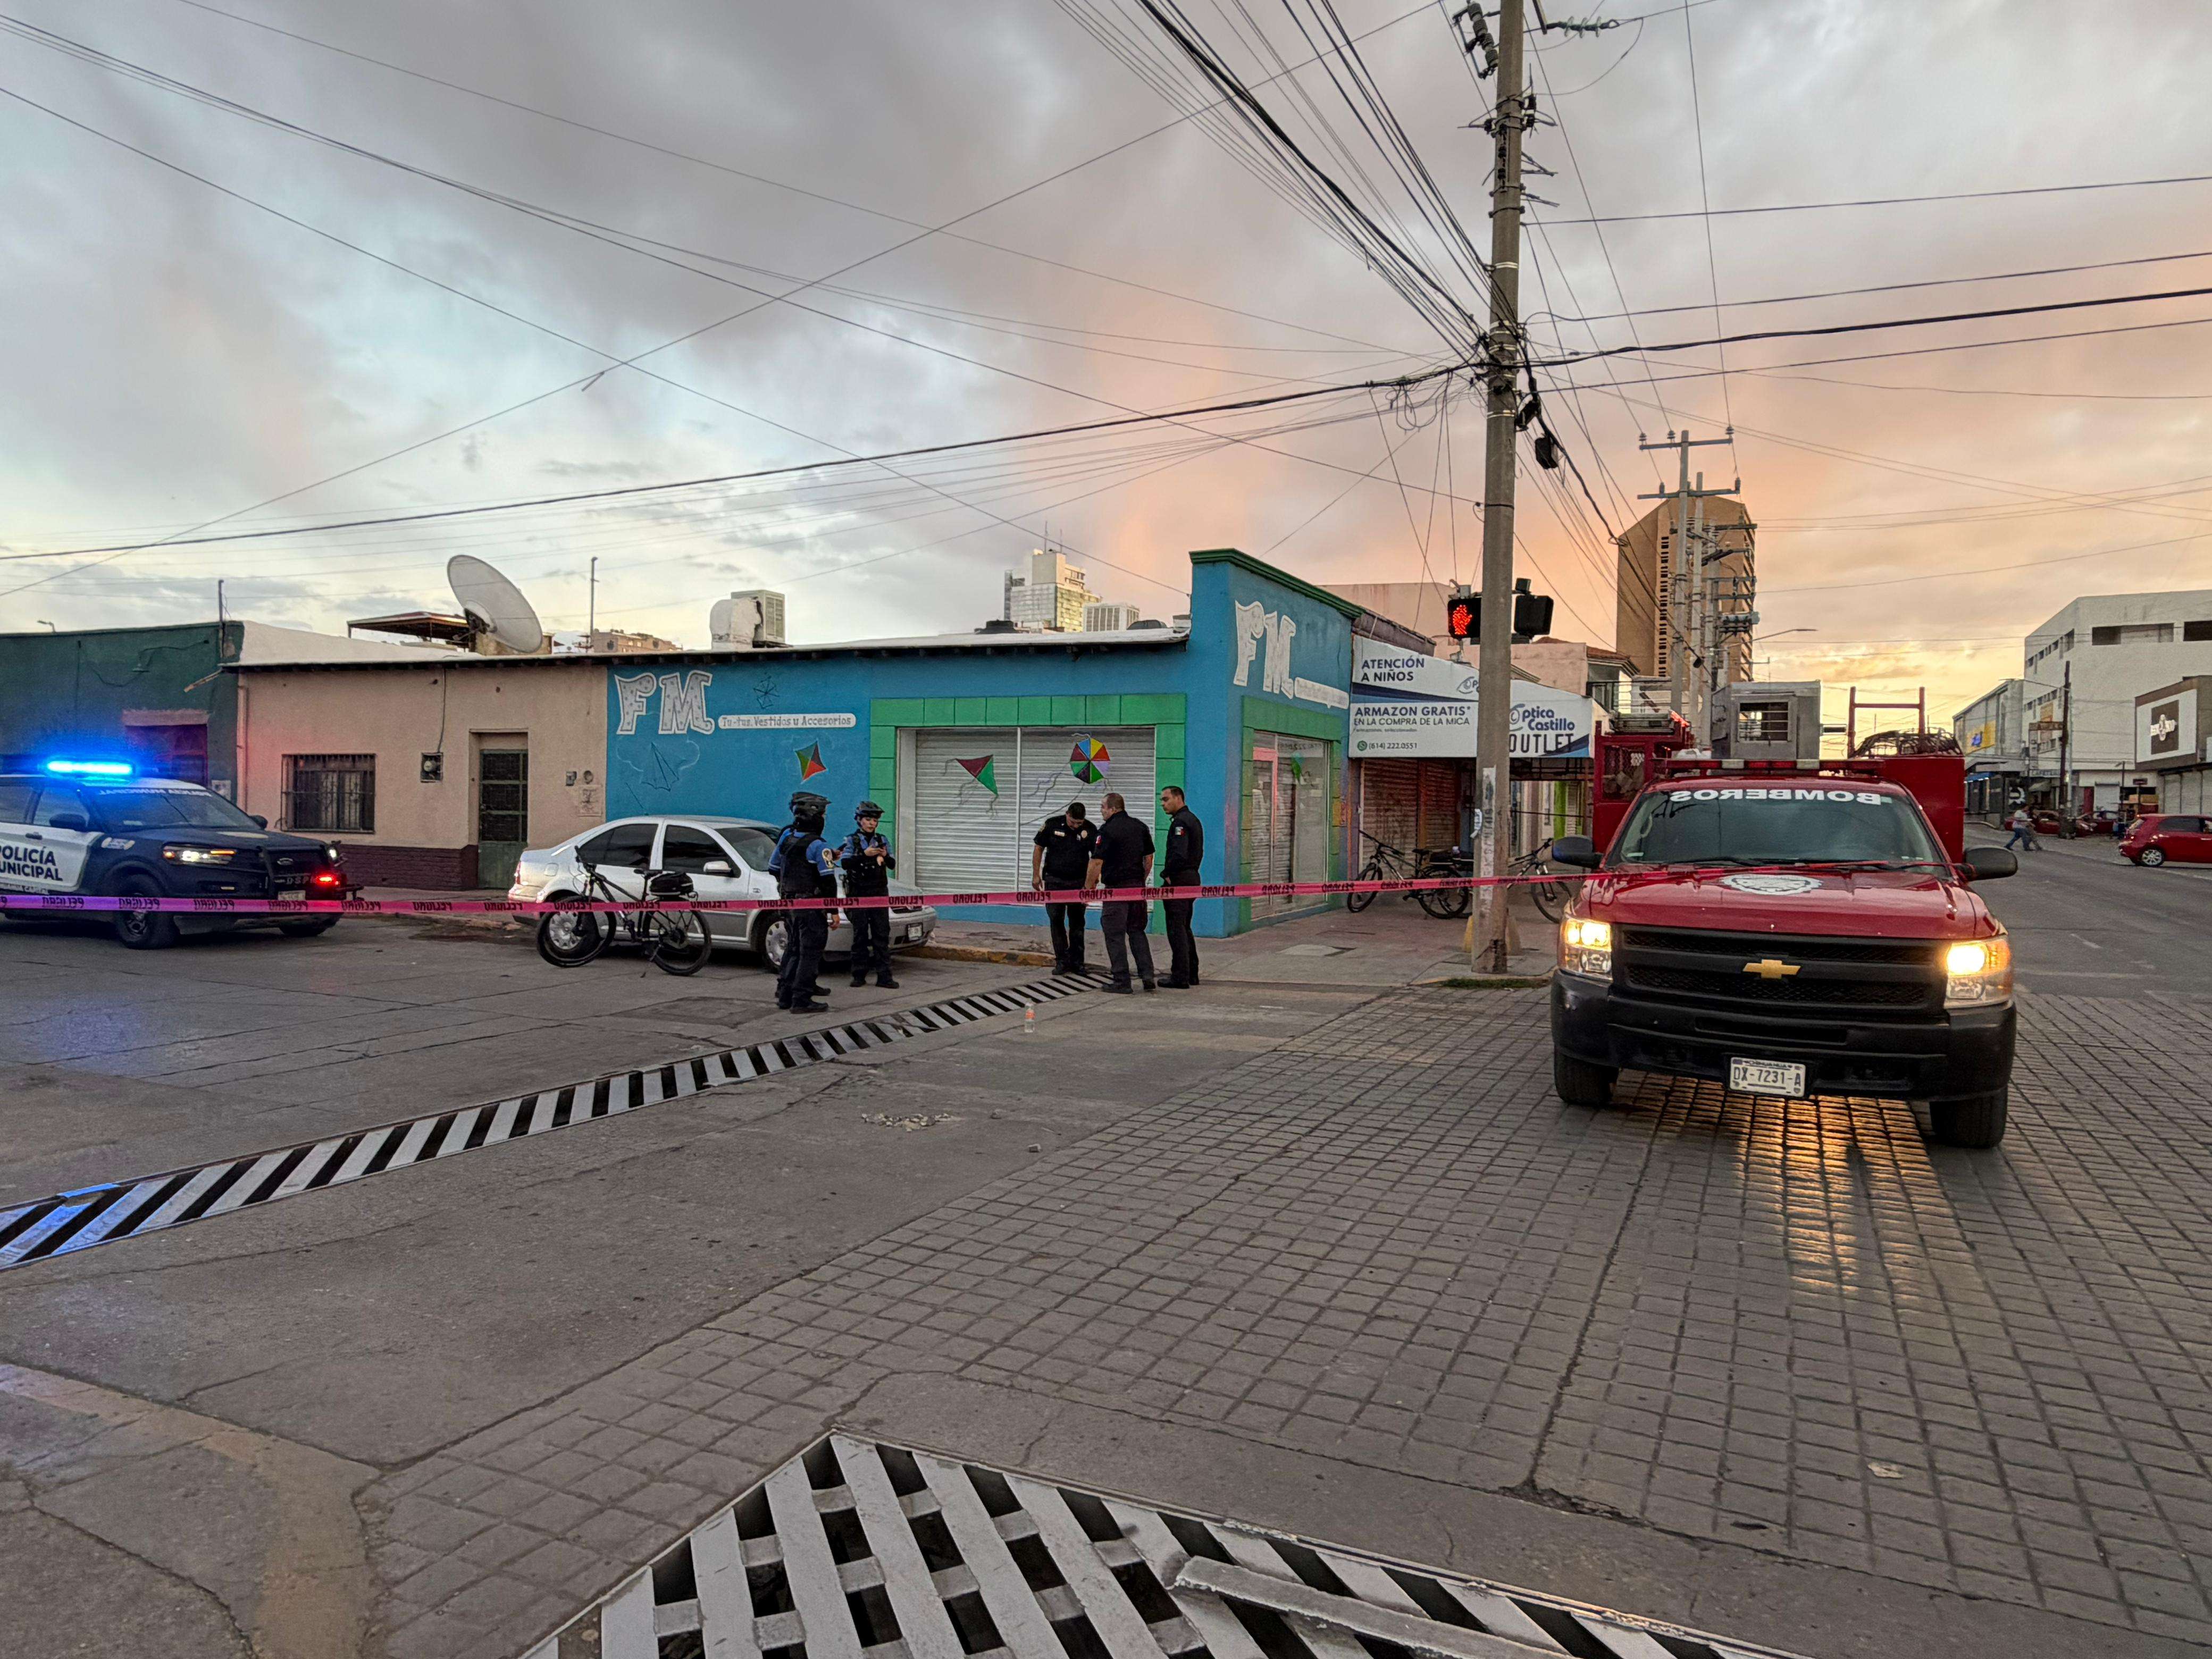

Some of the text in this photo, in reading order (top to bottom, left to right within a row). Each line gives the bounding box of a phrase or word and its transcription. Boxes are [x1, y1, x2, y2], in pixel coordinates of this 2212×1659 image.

[1361, 655, 1425, 669] ATENCIÓN
[1361, 669, 1414, 682] A NIÑOS
[614, 670, 715, 735] FM
[1355, 706, 1418, 716] ARMAZON
[754, 715, 791, 726] Vestidos
[801, 715, 851, 726] Accesorios
[1528, 718, 1576, 731] Castillo
[1509, 733, 1574, 751] OUTLET
[0, 845, 56, 866] OLICÍA
[0, 861, 63, 882] UNICIPAL
[1733, 1066, 1801, 1087] DX-7231-A
